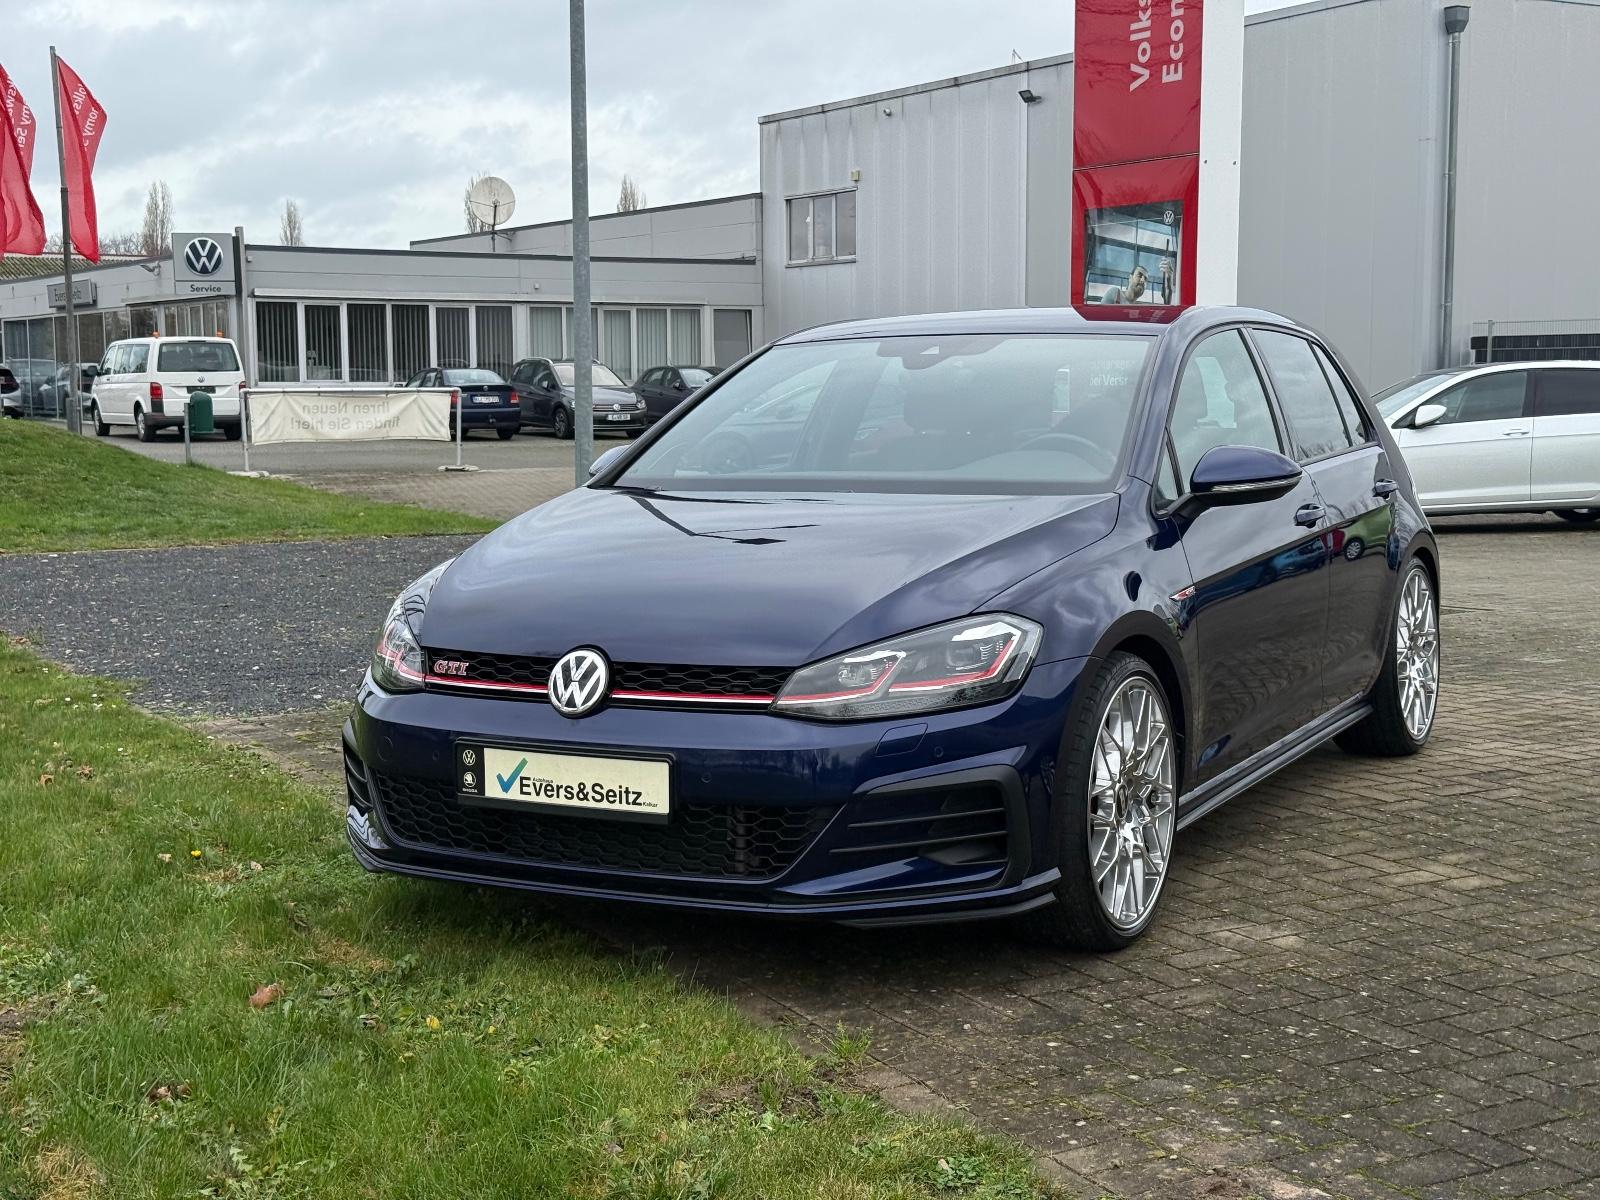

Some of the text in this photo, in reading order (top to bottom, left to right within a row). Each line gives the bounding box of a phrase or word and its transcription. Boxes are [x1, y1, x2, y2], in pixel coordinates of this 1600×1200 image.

[1162, 0, 1184, 83] Econ
[185, 238, 223, 275] VW
[190, 284, 222, 293] Service
[434, 659, 469, 675] GTI
[548, 650, 609, 715] VW
[519, 776, 643, 807] Evers&Seitz
